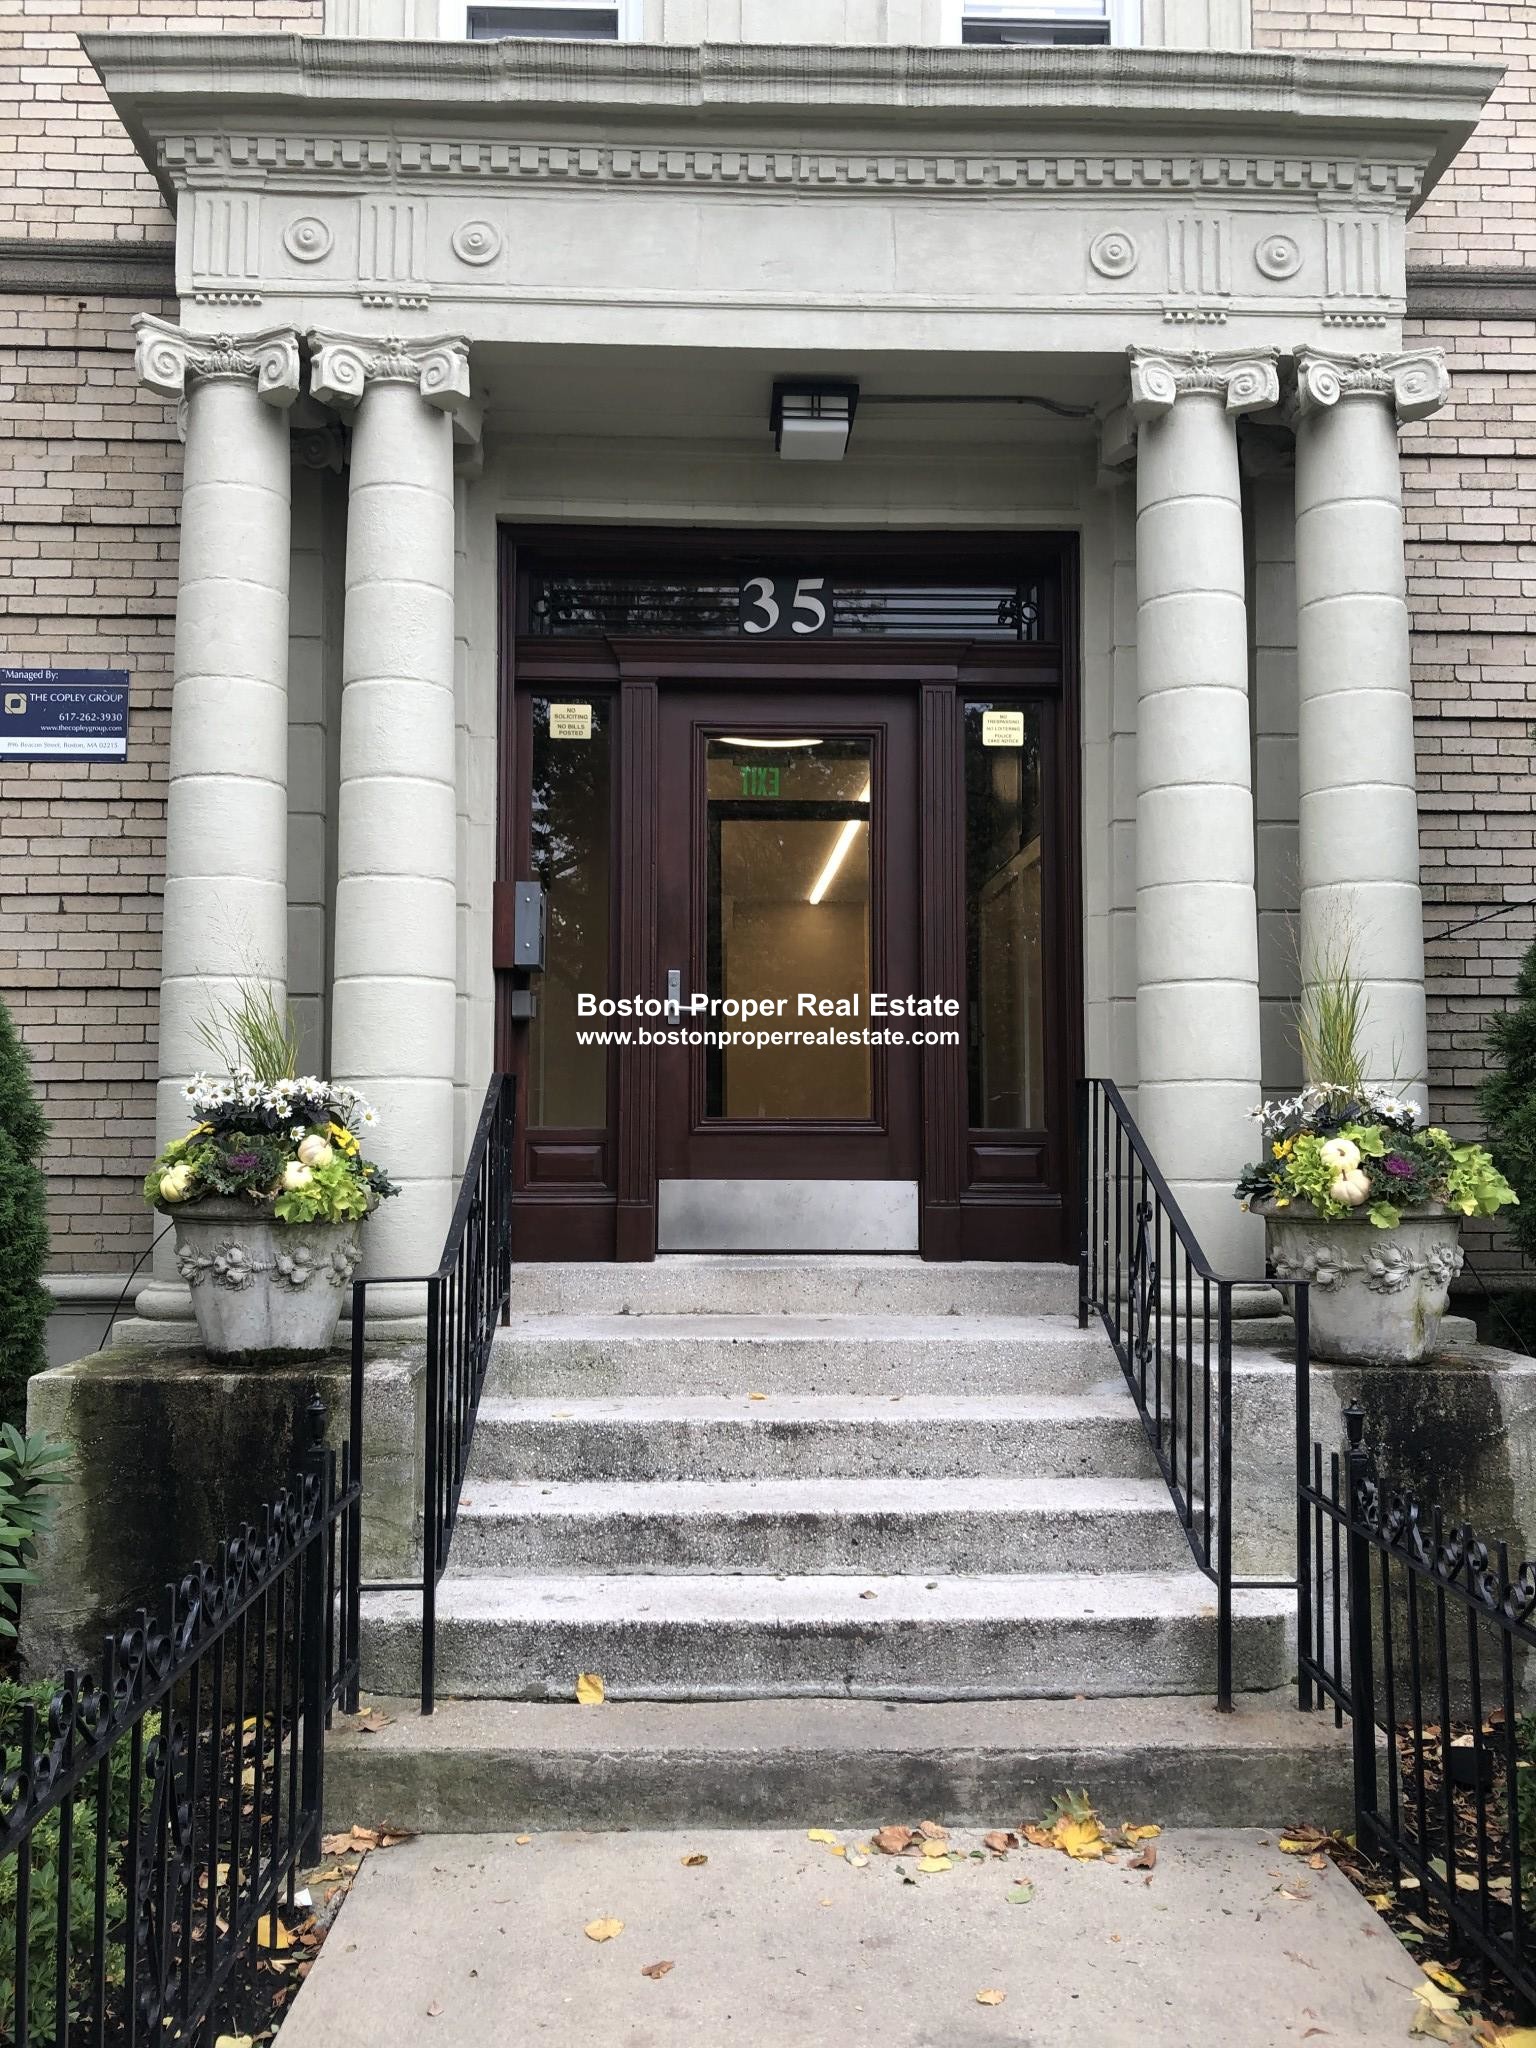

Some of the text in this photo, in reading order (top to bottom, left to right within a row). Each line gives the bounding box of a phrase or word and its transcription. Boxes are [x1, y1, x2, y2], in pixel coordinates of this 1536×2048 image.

[743, 577, 826, 634] 35
[5, 669, 59, 681] Managed By:
[30, 693, 123, 703] THE COPLEY GROUP
[58, 712, 123, 721] 617-262-3930
